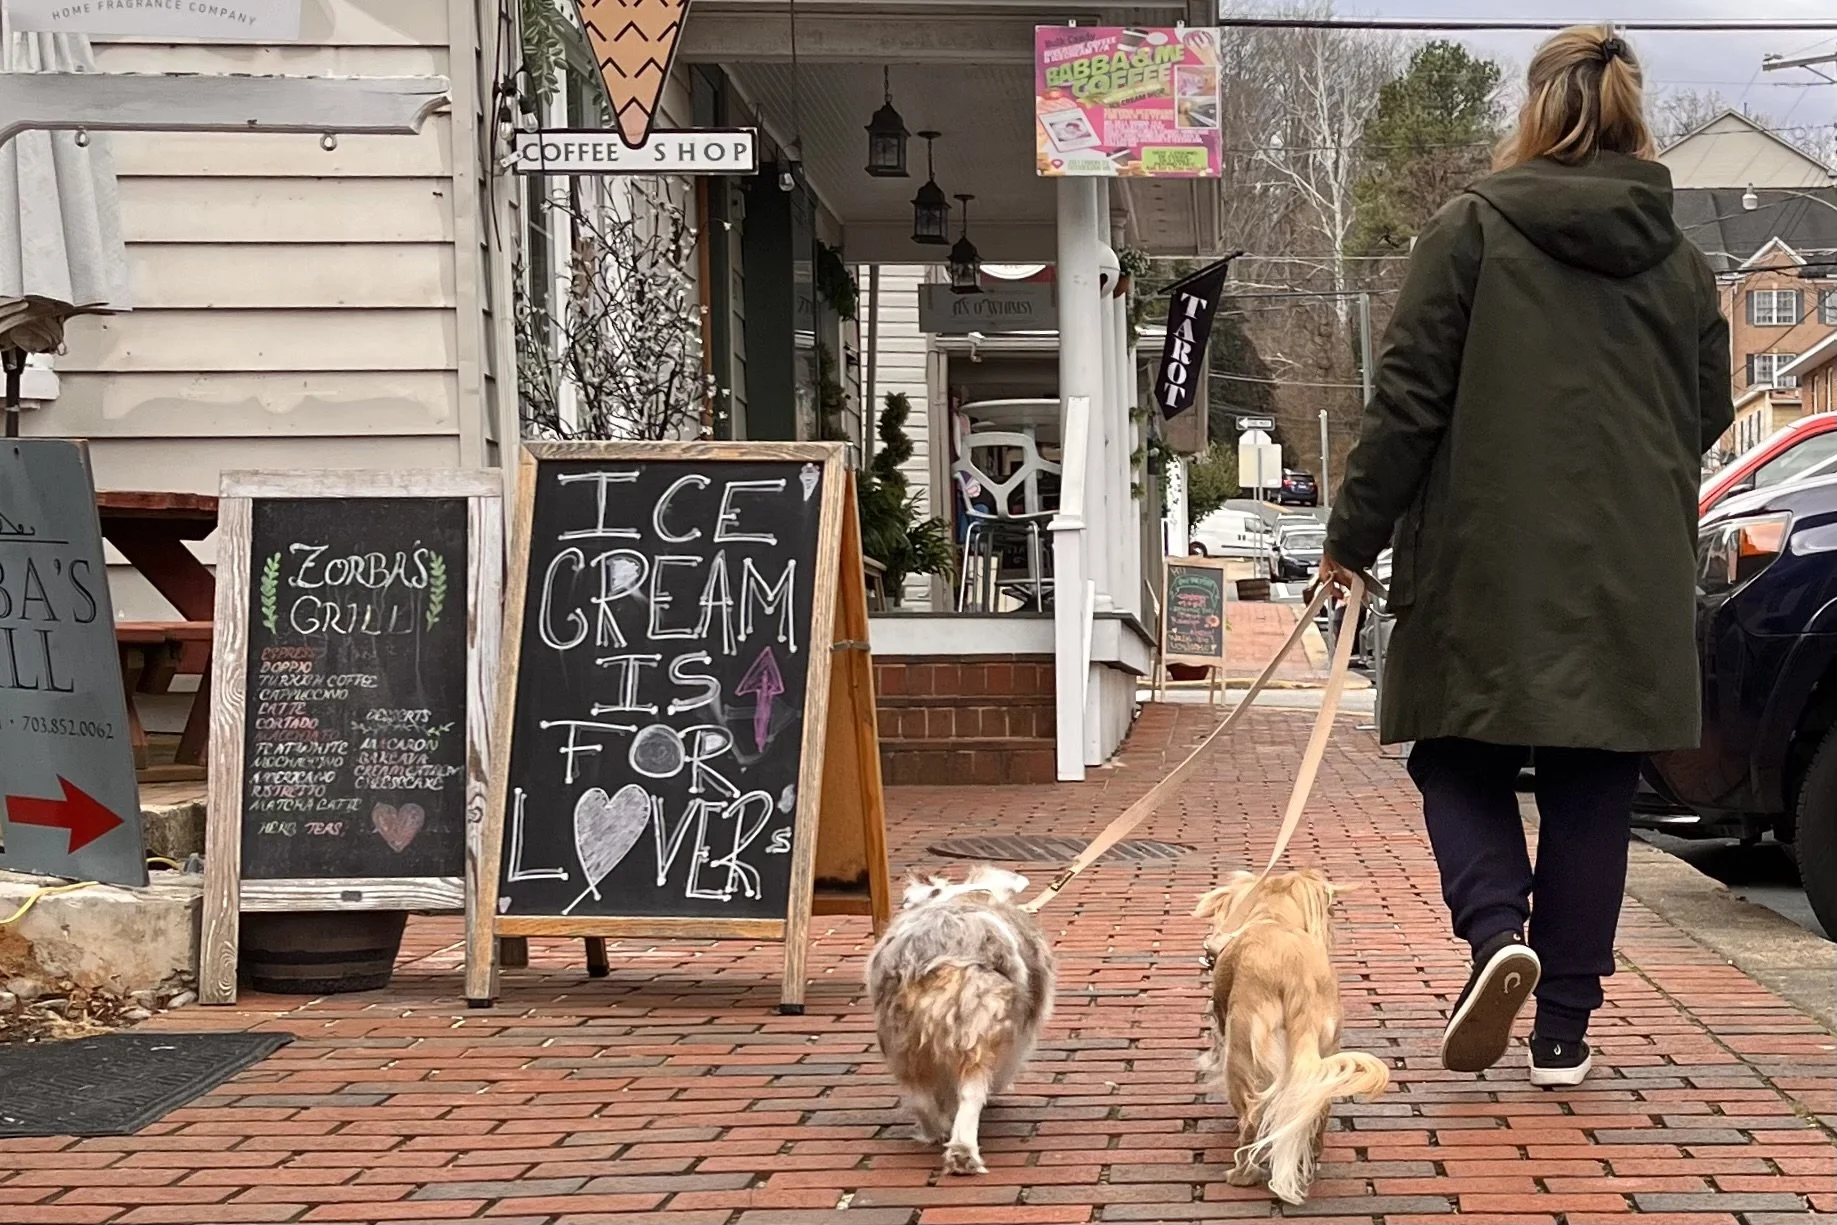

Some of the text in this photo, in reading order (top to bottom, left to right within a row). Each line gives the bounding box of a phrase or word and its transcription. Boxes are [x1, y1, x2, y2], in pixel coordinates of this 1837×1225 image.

[52, 0, 257, 26] HOME FRAGRANCE COMPANY
[1045, 50, 1131, 87] BABBA
[1131, 47, 1151, 67] &
[1154, 44, 1185, 64] ME
[1072, 62, 1172, 98] COFFEE
[522, 142, 748, 162] COFFEE SHOP
[1163, 292, 1208, 408] TAROT
[558, 471, 788, 545] ICE
[288, 540, 429, 589] ZORBA'S
[290, 595, 414, 635] GRILL
[539, 547, 798, 655] CREAM
[326, 674, 378, 688] COFFEE
[590, 650, 722, 715] IS
[22, 715, 115, 739] 703.852.0062
[255, 717, 319, 730] CORTADO
[258, 702, 307, 715] LATTE
[540, 720, 741, 798] FOR
[249, 799, 362, 812] MATCHA LATTE
